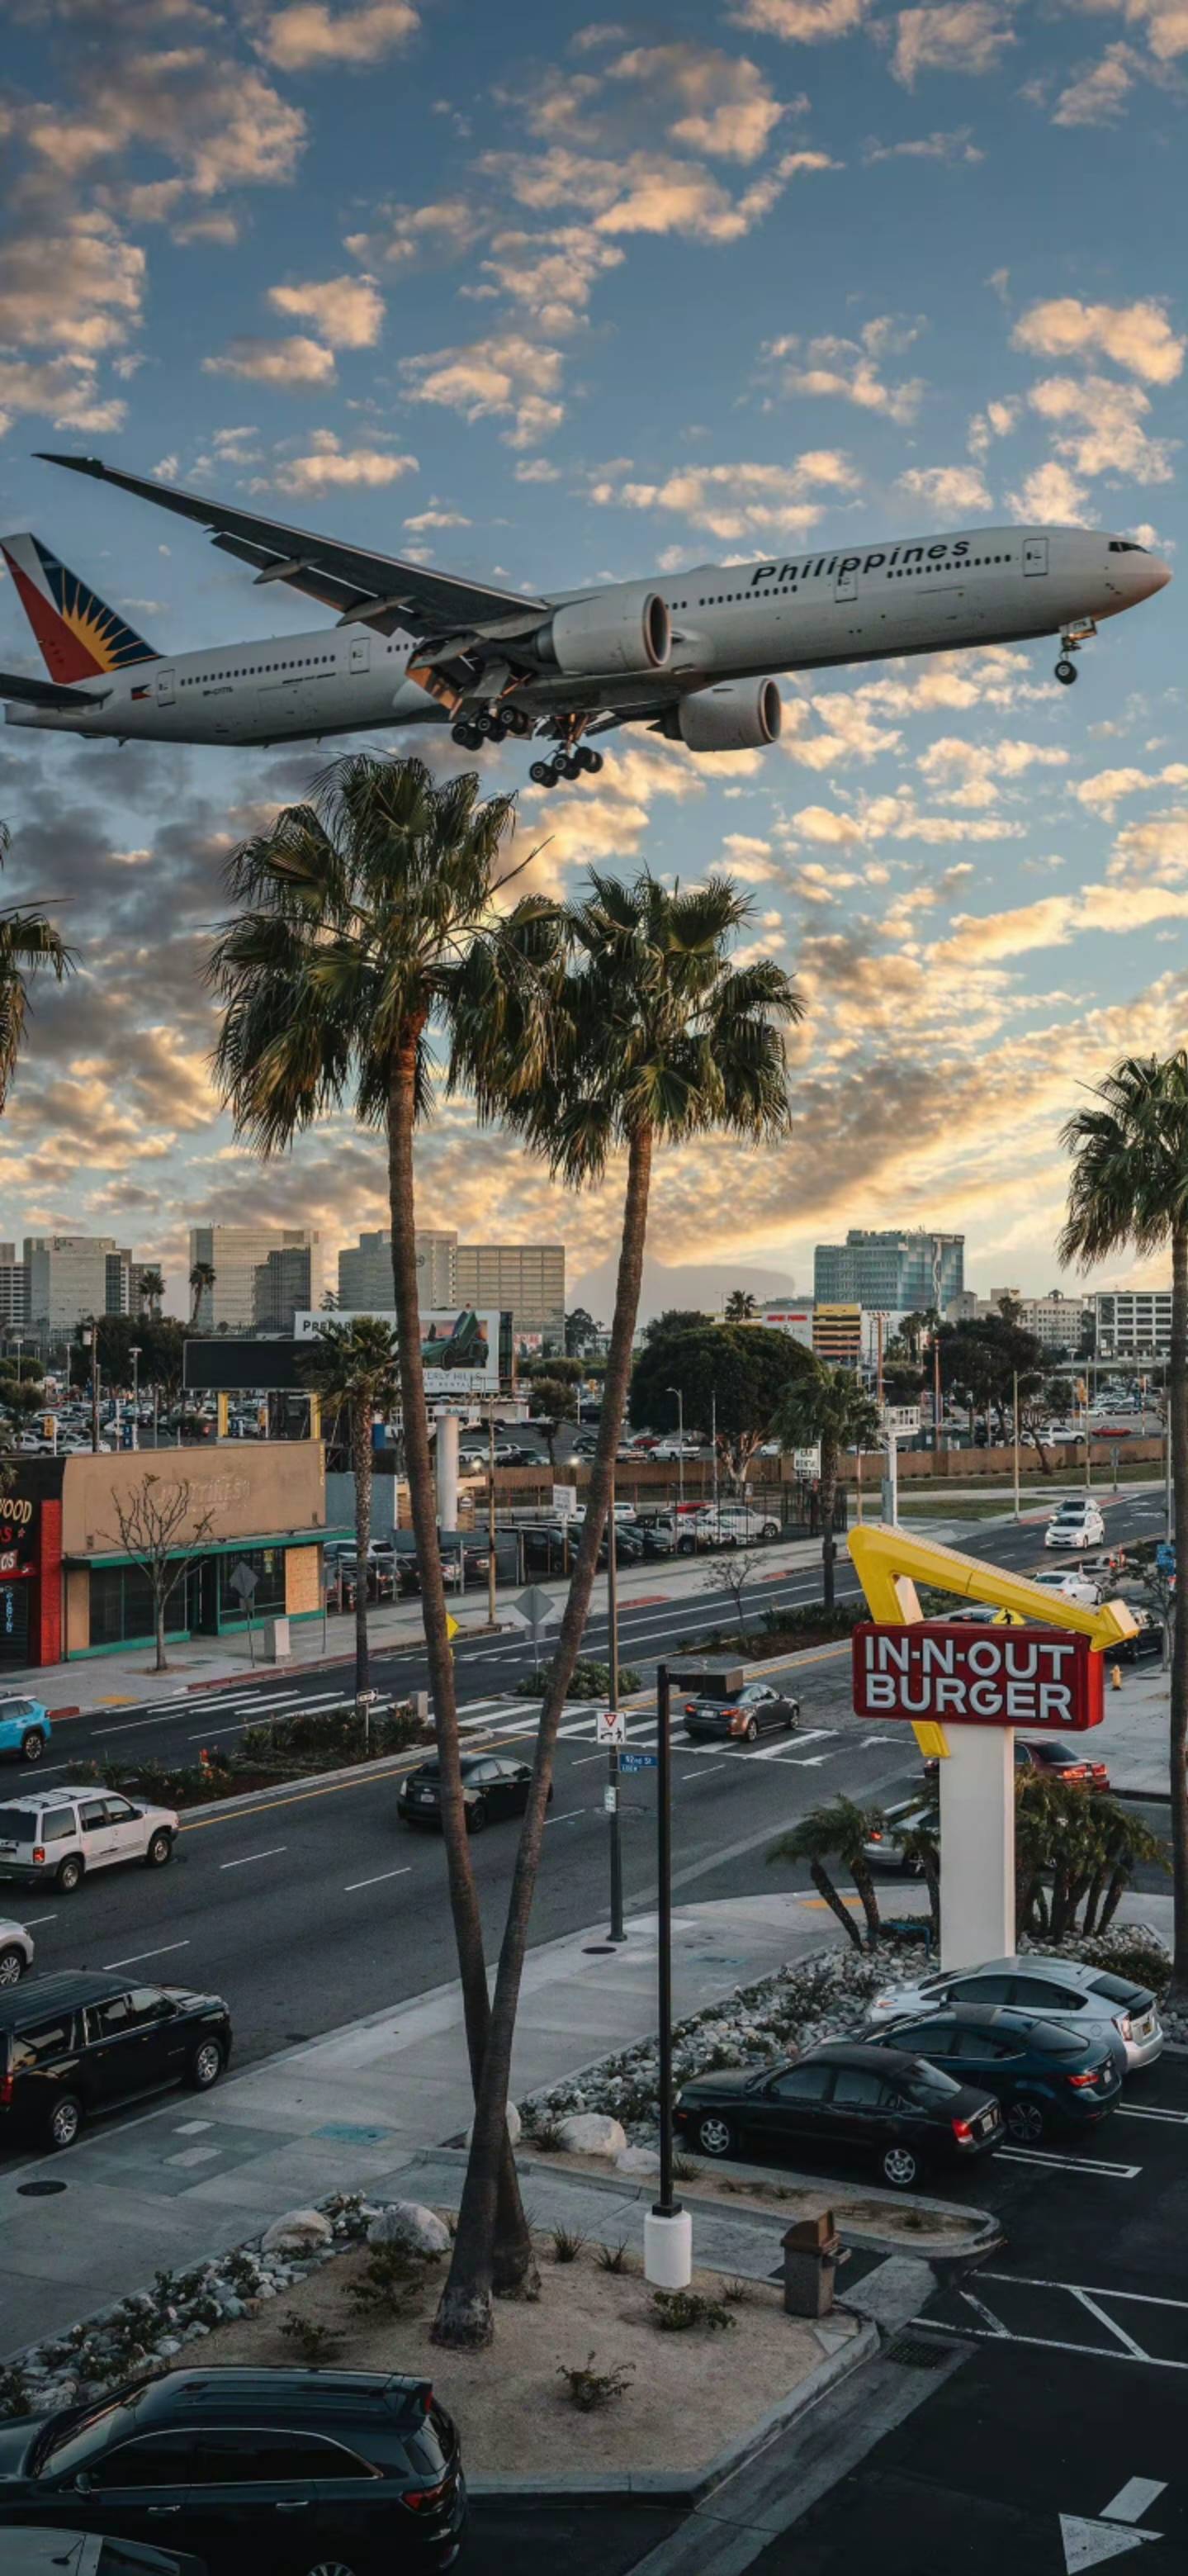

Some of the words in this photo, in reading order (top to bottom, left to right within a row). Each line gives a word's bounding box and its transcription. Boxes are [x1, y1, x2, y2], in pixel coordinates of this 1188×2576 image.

[750, 540, 971, 586] Philippines
[865, 1635, 1075, 1681] IN-N-OUT
[865, 1672, 1072, 1720] BURGER
